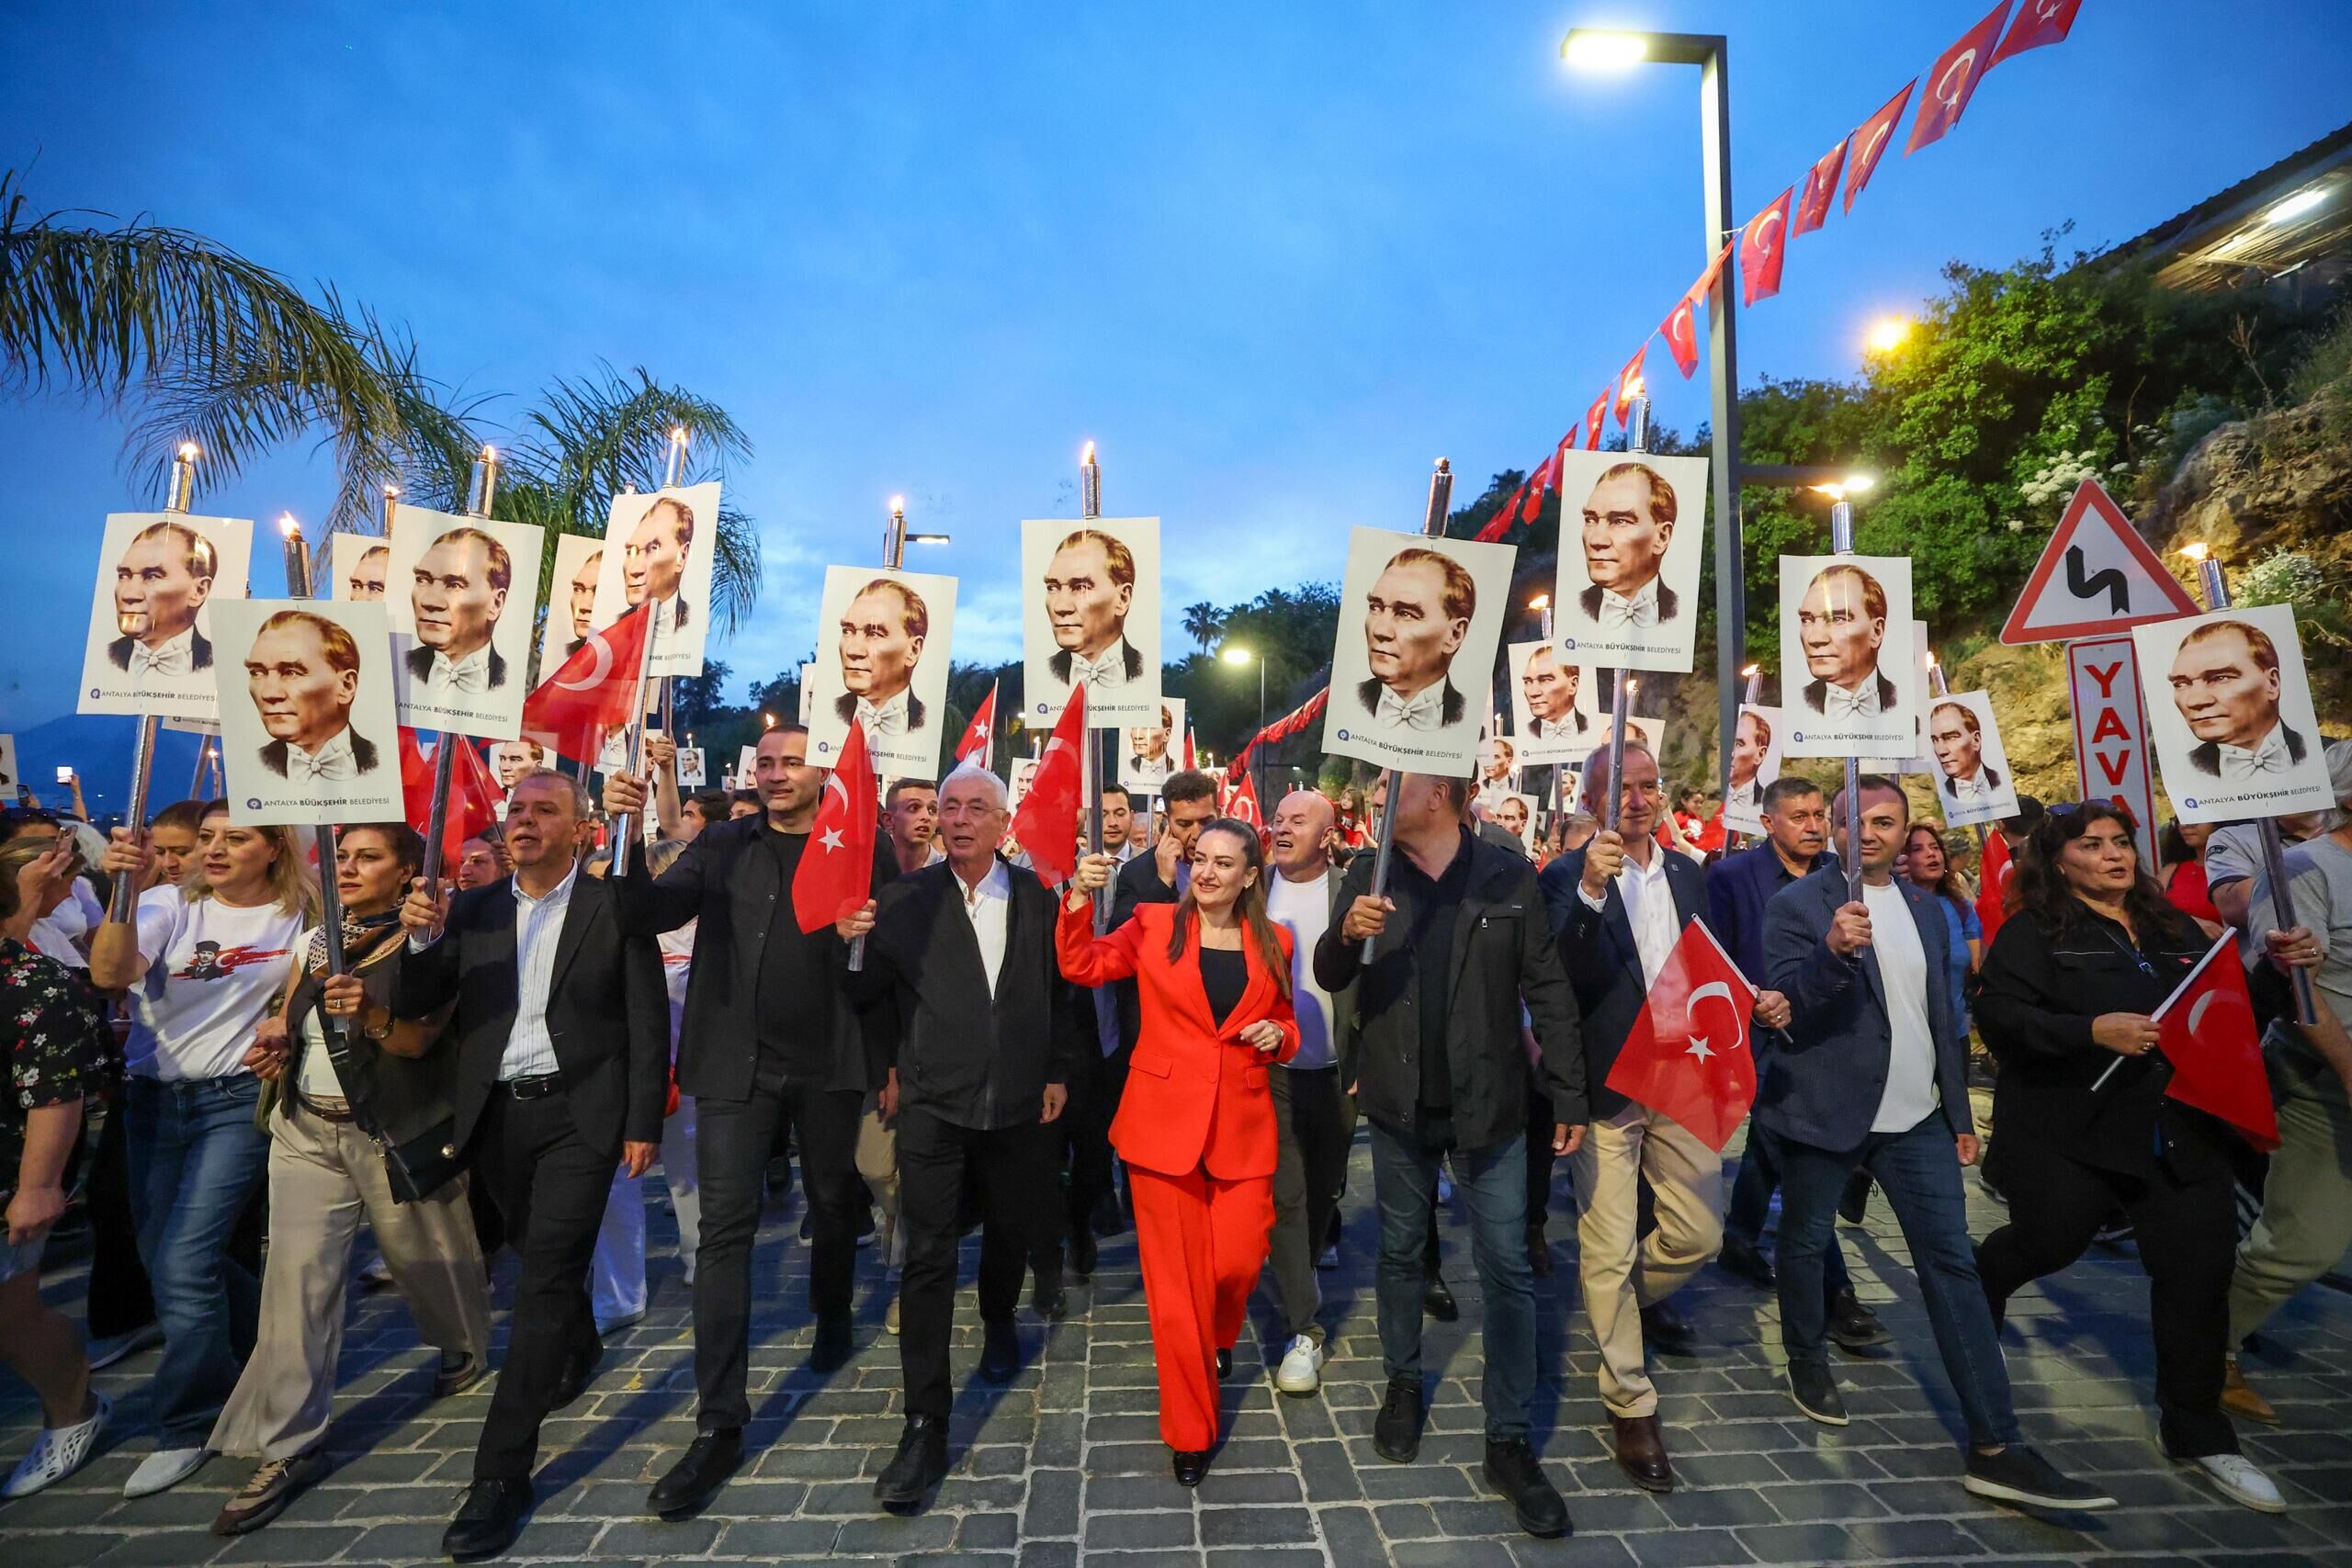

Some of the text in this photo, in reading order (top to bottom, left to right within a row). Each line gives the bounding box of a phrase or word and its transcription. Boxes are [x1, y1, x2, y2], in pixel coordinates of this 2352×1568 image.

[1577, 641, 1681, 654] ANTALYA BÜYÜKŞEHİR BELEDİYESİ
[177, 693, 215, 702] BELEDİYES
[398, 702, 431, 713] ANTALYA
[475, 712, 508, 723] BELEDİYESİ
[1117, 704, 1149, 712] BELEDİYESİ
[1834, 732, 1873, 740] BÜYÜKŞEHİR
[1874, 733, 1904, 741] BELEDİYESİ
[1351, 734, 1463, 760] ANTALYA BÜYÜKŞEHİR BELEDİYESİ
[2083, 661, 2141, 829] YAVA
[867, 748, 927, 762] ÜKŞEHİR BELEDİYESİ
[349, 796, 390, 806] BELEDİYESİ
[2199, 785, 2321, 806] ANTALYA BÜYÜKŞEHİR BELEDİYESİ
